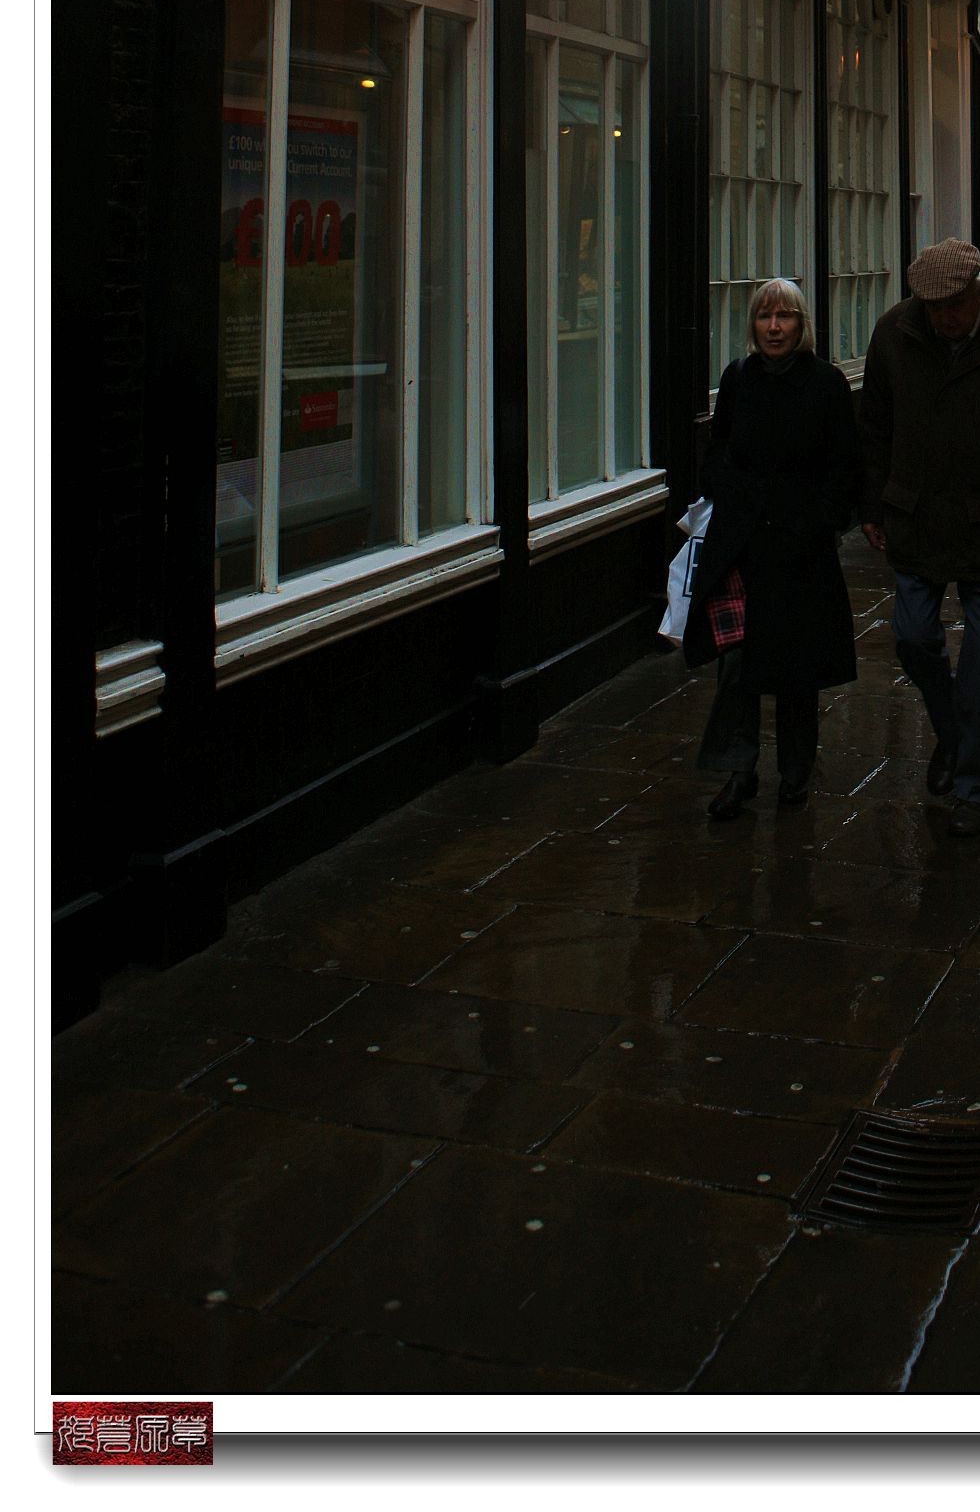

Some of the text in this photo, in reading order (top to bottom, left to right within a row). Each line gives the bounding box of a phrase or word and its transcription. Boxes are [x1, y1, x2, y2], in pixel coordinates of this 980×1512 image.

[228, 135, 253, 152] £100
[300, 140, 328, 158] switch
[228, 155, 264, 175] unique
